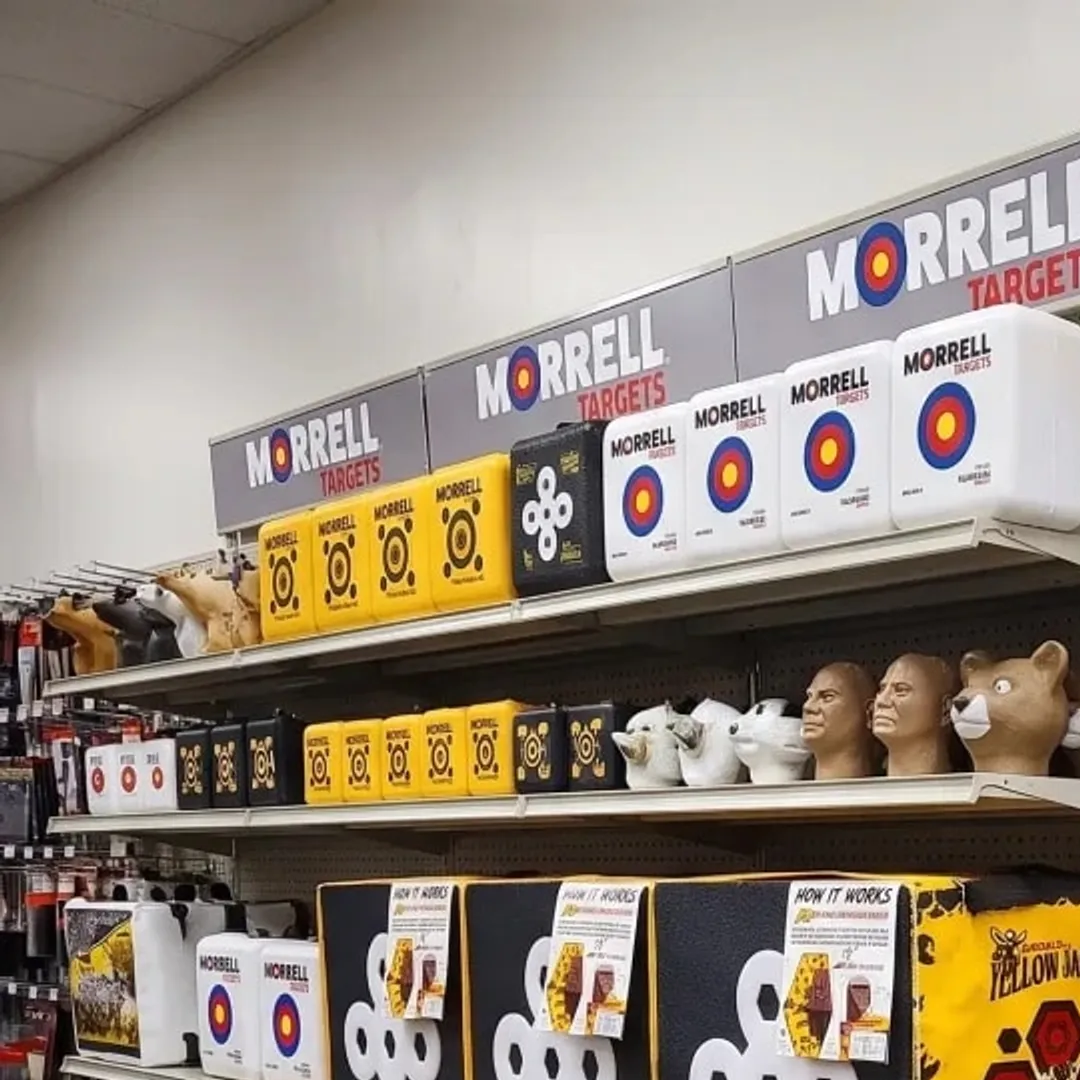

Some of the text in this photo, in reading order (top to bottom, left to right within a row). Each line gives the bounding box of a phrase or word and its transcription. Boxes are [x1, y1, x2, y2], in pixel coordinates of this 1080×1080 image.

[475, 307, 665, 420] MORRELL
[904, 333, 991, 376] MORRELL
[577, 372, 666, 420] TARGETS
[791, 366, 869, 405] MORRELL
[695, 394, 766, 429] MORRELL
[245, 402, 379, 488] MORRELL
[611, 426, 675, 458] MORRELL
[320, 457, 380, 497] TARGETS
[436, 476, 482, 503] MORRELL
[374, 497, 414, 522] MORRELL
[794, 886, 893, 905] HOW IT WORKS
[990, 951, 1060, 1001] YELLOW
